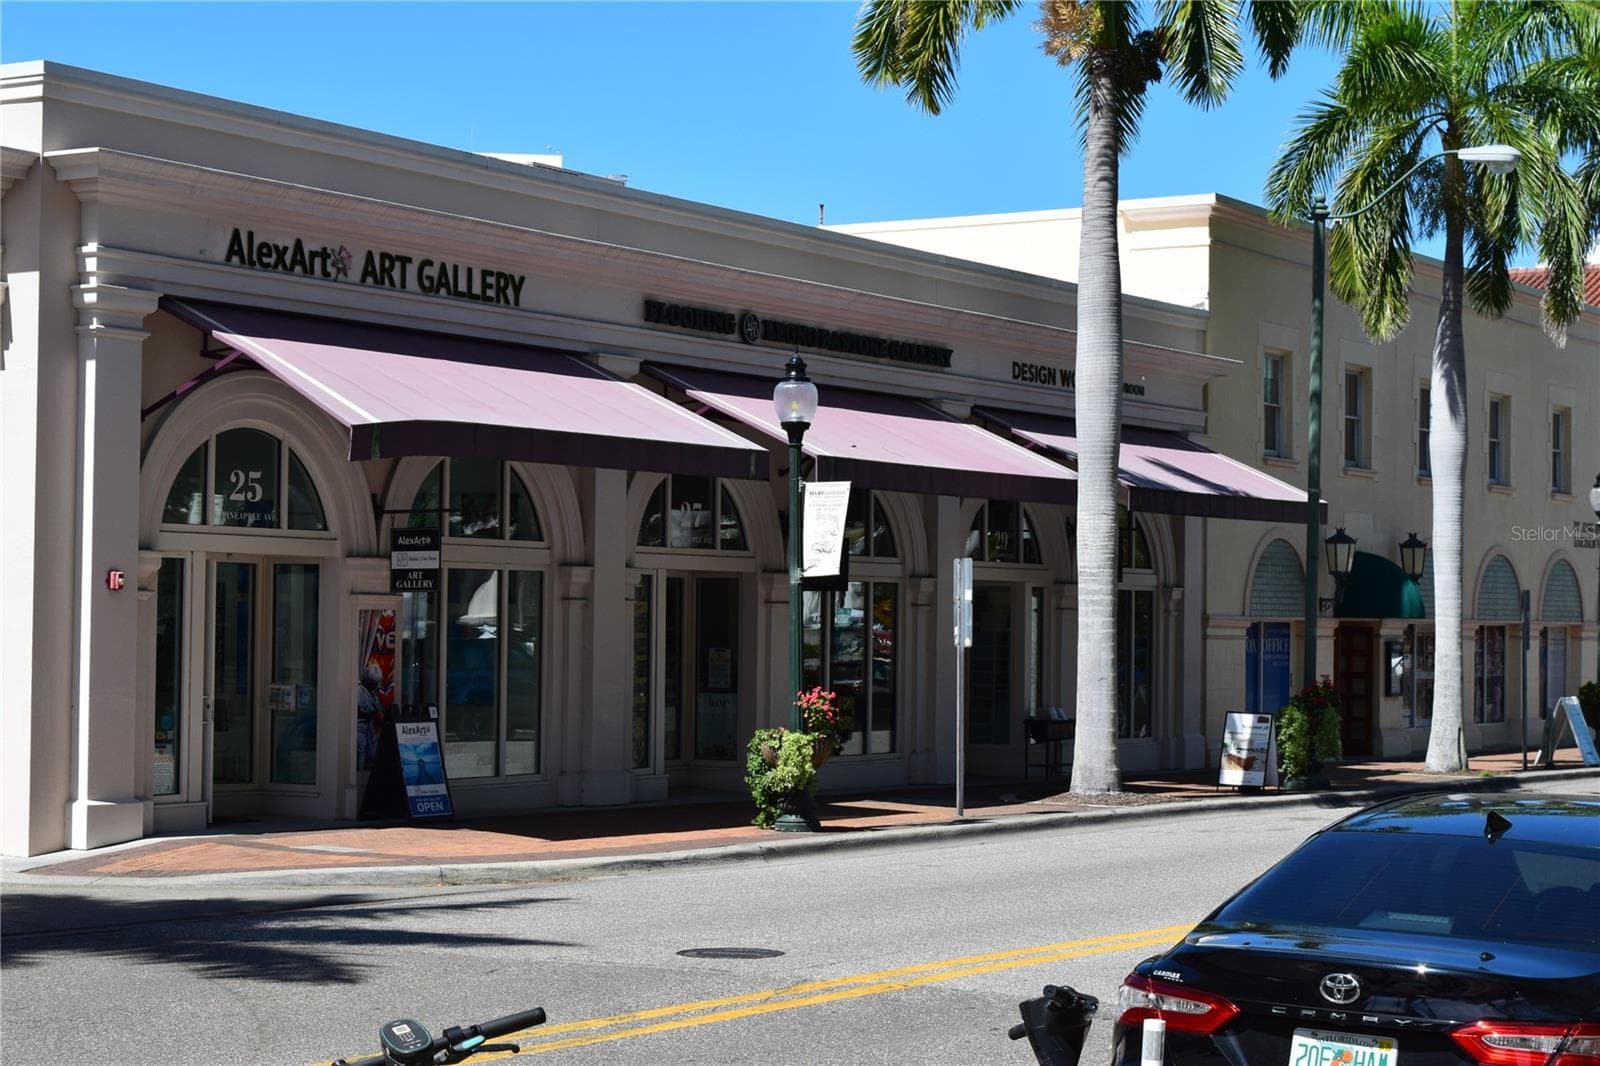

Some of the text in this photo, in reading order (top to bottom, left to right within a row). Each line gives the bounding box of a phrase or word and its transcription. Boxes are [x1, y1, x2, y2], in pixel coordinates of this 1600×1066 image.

[225, 228, 525, 307] AlexArt ART GALLERY
[1012, 361, 1057, 386] DESIGN
[230, 469, 263, 502] 25
[223, 511, 262, 521] PINEAPPLE
[406, 571, 424, 580] ART
[395, 579, 433, 589] GALLERY
[416, 801, 445, 813] OPEN
